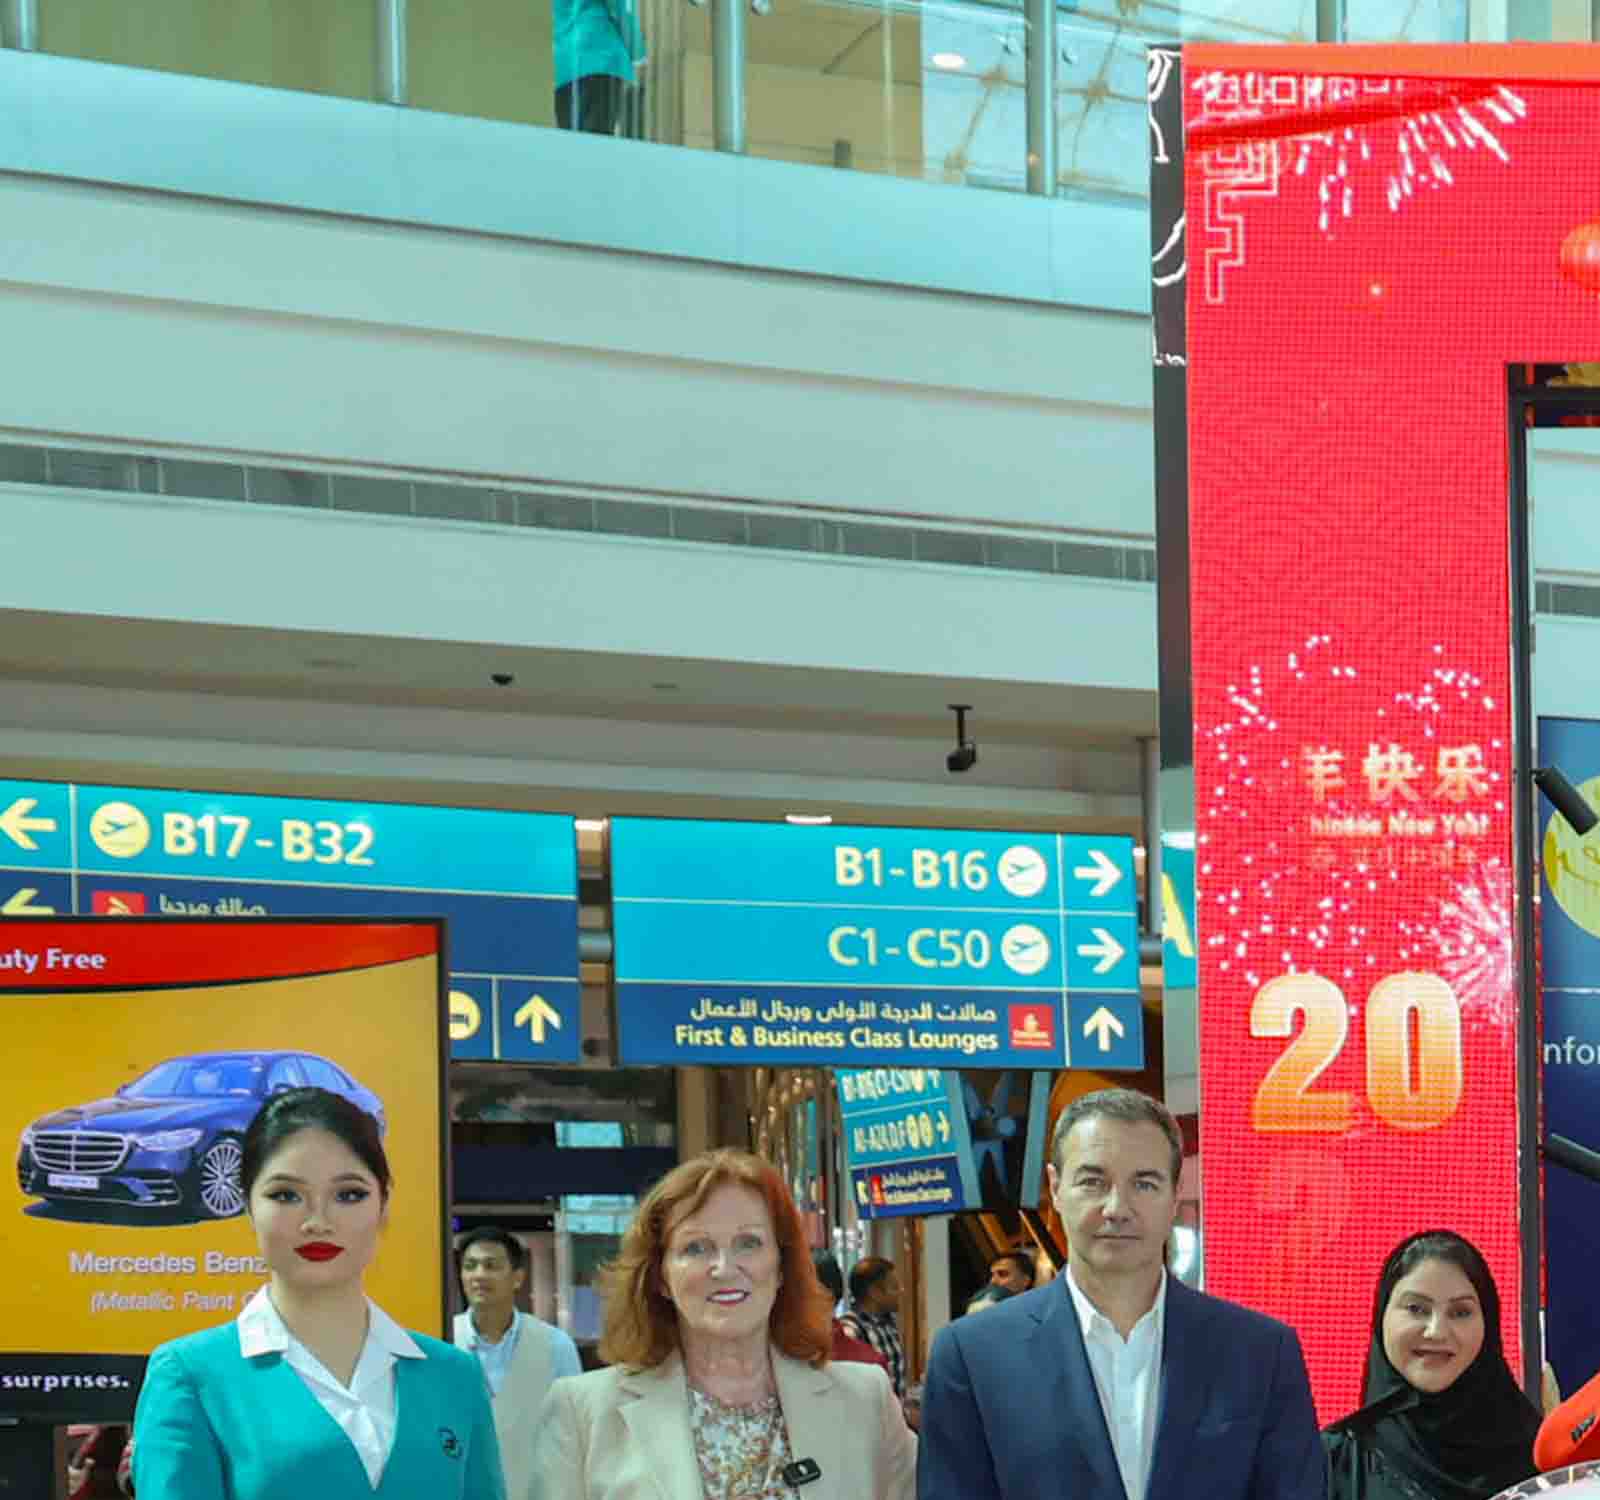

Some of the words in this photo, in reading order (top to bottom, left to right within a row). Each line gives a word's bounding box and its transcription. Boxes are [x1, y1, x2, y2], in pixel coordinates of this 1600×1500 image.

[0, 948, 39, 974] uty
[46, 947, 107, 969] Free
[675, 1025, 726, 1048] First
[729, 1025, 748, 1048] &
[753, 1025, 846, 1048] Business
[849, 1026, 904, 1049] Class
[908, 1028, 999, 1054] Lounges
[1250, 971, 1463, 1134] 20
[69, 1250, 197, 1274] Mercedes
[205, 1250, 269, 1274] Benz
[182, 1289, 237, 1313] Paint
